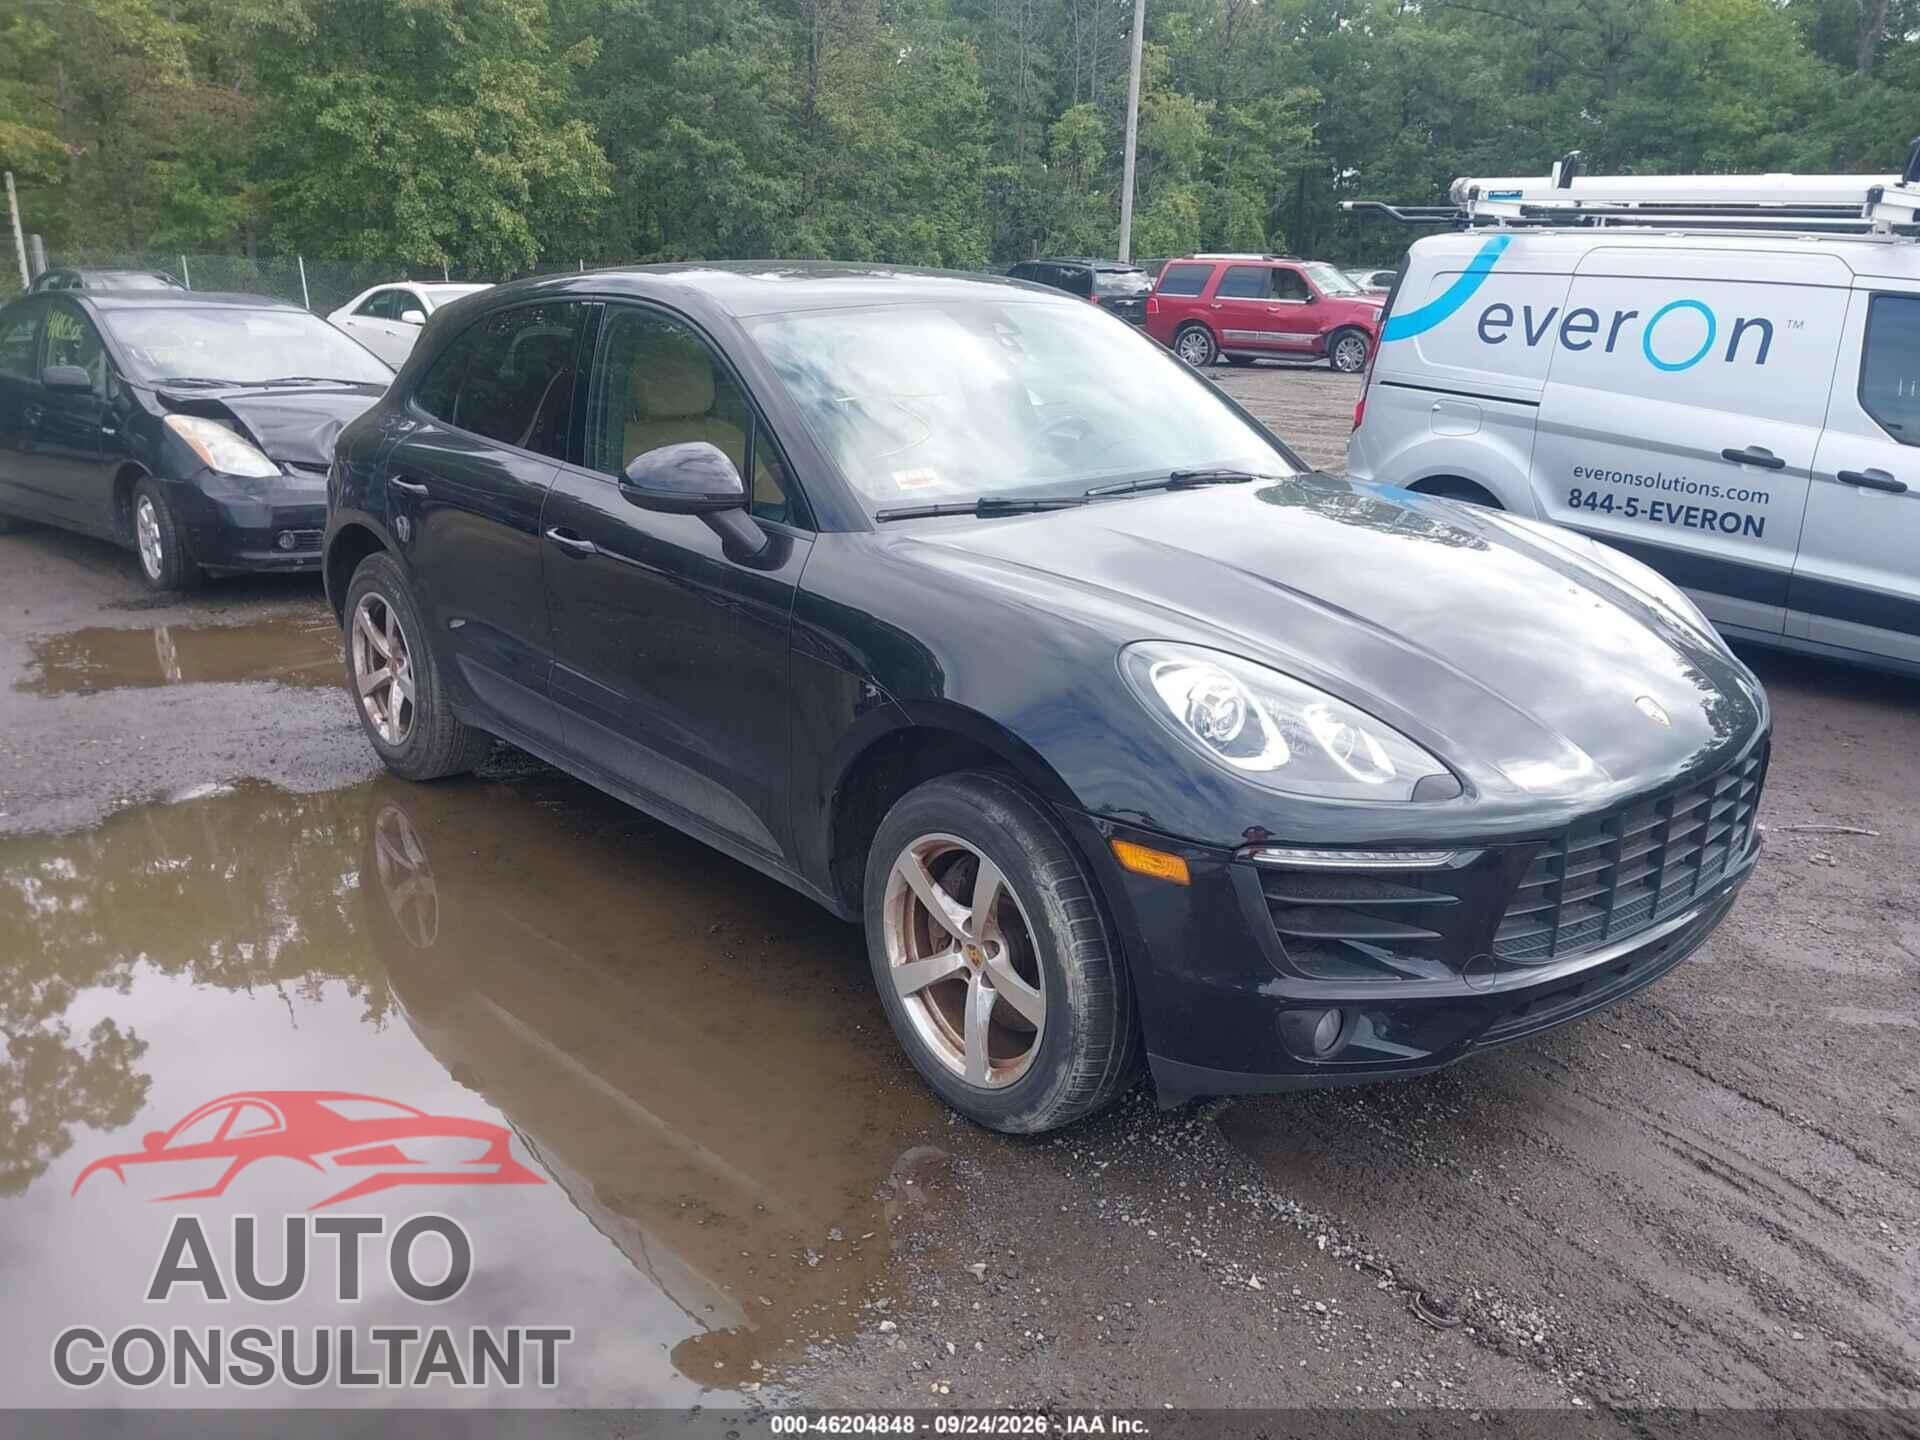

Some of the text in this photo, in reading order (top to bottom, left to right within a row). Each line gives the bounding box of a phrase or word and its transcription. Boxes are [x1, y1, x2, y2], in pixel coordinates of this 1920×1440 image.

[1477, 299, 1806, 372] everOn TM
[1573, 465, 1770, 504] everonsolutions.com
[1568, 488, 1766, 538] 844-5-EVERON
